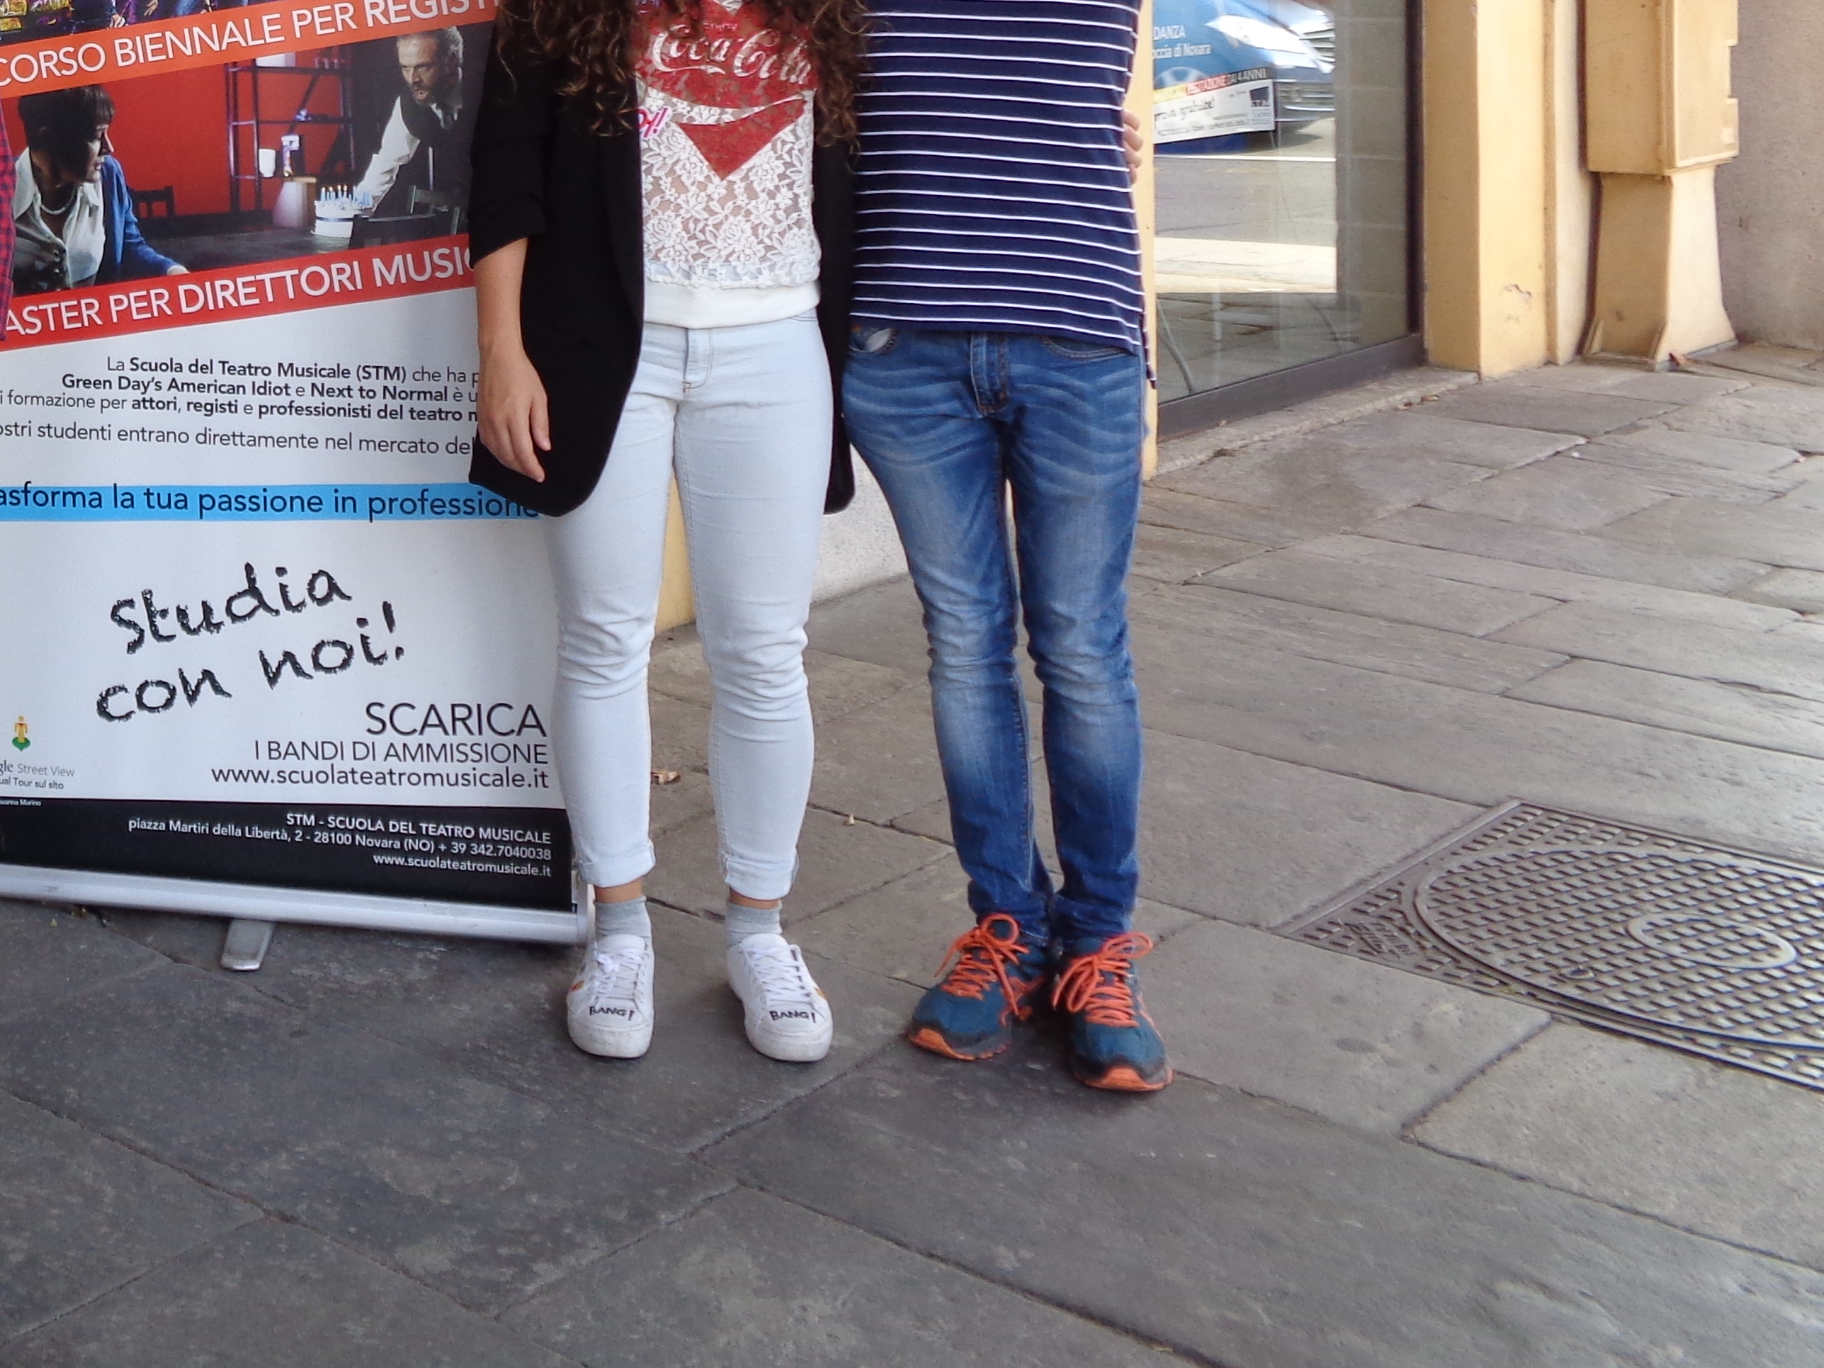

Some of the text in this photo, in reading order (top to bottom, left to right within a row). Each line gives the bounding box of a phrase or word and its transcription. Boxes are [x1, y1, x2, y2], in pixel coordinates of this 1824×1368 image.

[113, 12, 286, 69] BIENNALE
[291, 0, 358, 39] PER
[5, 297, 104, 336] ASTER
[109, 287, 173, 323] PER
[178, 260, 363, 315] DIRETTORI
[107, 357, 125, 372] La
[130, 357, 183, 373] Scuola
[188, 359, 213, 374] del
[218, 360, 272, 377] Teatro
[277, 362, 351, 379] Musicale
[356, 364, 407, 383] (STM)
[412, 365, 442, 382] che
[447, 366, 466, 382] ha
[62, 373, 113, 390] Green
[167, 378, 246, 396] American
[251, 381, 292, 396] Idiot
[295, 386, 306, 396] e
[310, 382, 354, 399] Next
[358, 385, 377, 399] to
[382, 385, 448, 401] Normal
[453, 387, 464, 402] è
[7, 389, 96, 408] formazione
[101, 395, 127, 414] per
[131, 397, 182, 413] attori,
[186, 398, 239, 417] registi
[243, 403, 253, 414] e
[258, 401, 372, 419] professionisti
[377, 404, 403, 420] del
[408, 407, 463, 421] teatro
[37, 421, 112, 441] studenti
[117, 426, 190, 444] entrano
[195, 429, 319, 449] direttamente
[325, 432, 353, 450] nel
[358, 435, 439, 454] mercato
[112, 483, 137, 510] la
[144, 487, 190, 511] tua
[198, 486, 325, 520] passione
[333, 485, 357, 514] in
[96, 600, 405, 723] con noi!
[365, 702, 548, 737] SCARICA
[254, 740, 549, 765] I BANDI DI AMMISSIONE
[13, 777, 32, 787] Tour
[34, 779, 46, 788] sul
[48, 780, 64, 790] sito
[17, 763, 48, 776] Street
[50, 766, 75, 778] View
[211, 763, 549, 789] www.scuolateatromusicale.it
[128, 818, 552, 860] piazza Martiri della Libertà, 2 28100 Novara (NO) 39 342.7040038
[286, 813, 552, 844] STM SCUOLA DEL TEATRO MUSICALE
[373, 853, 551, 877] www.scuolateatromusicale.it
